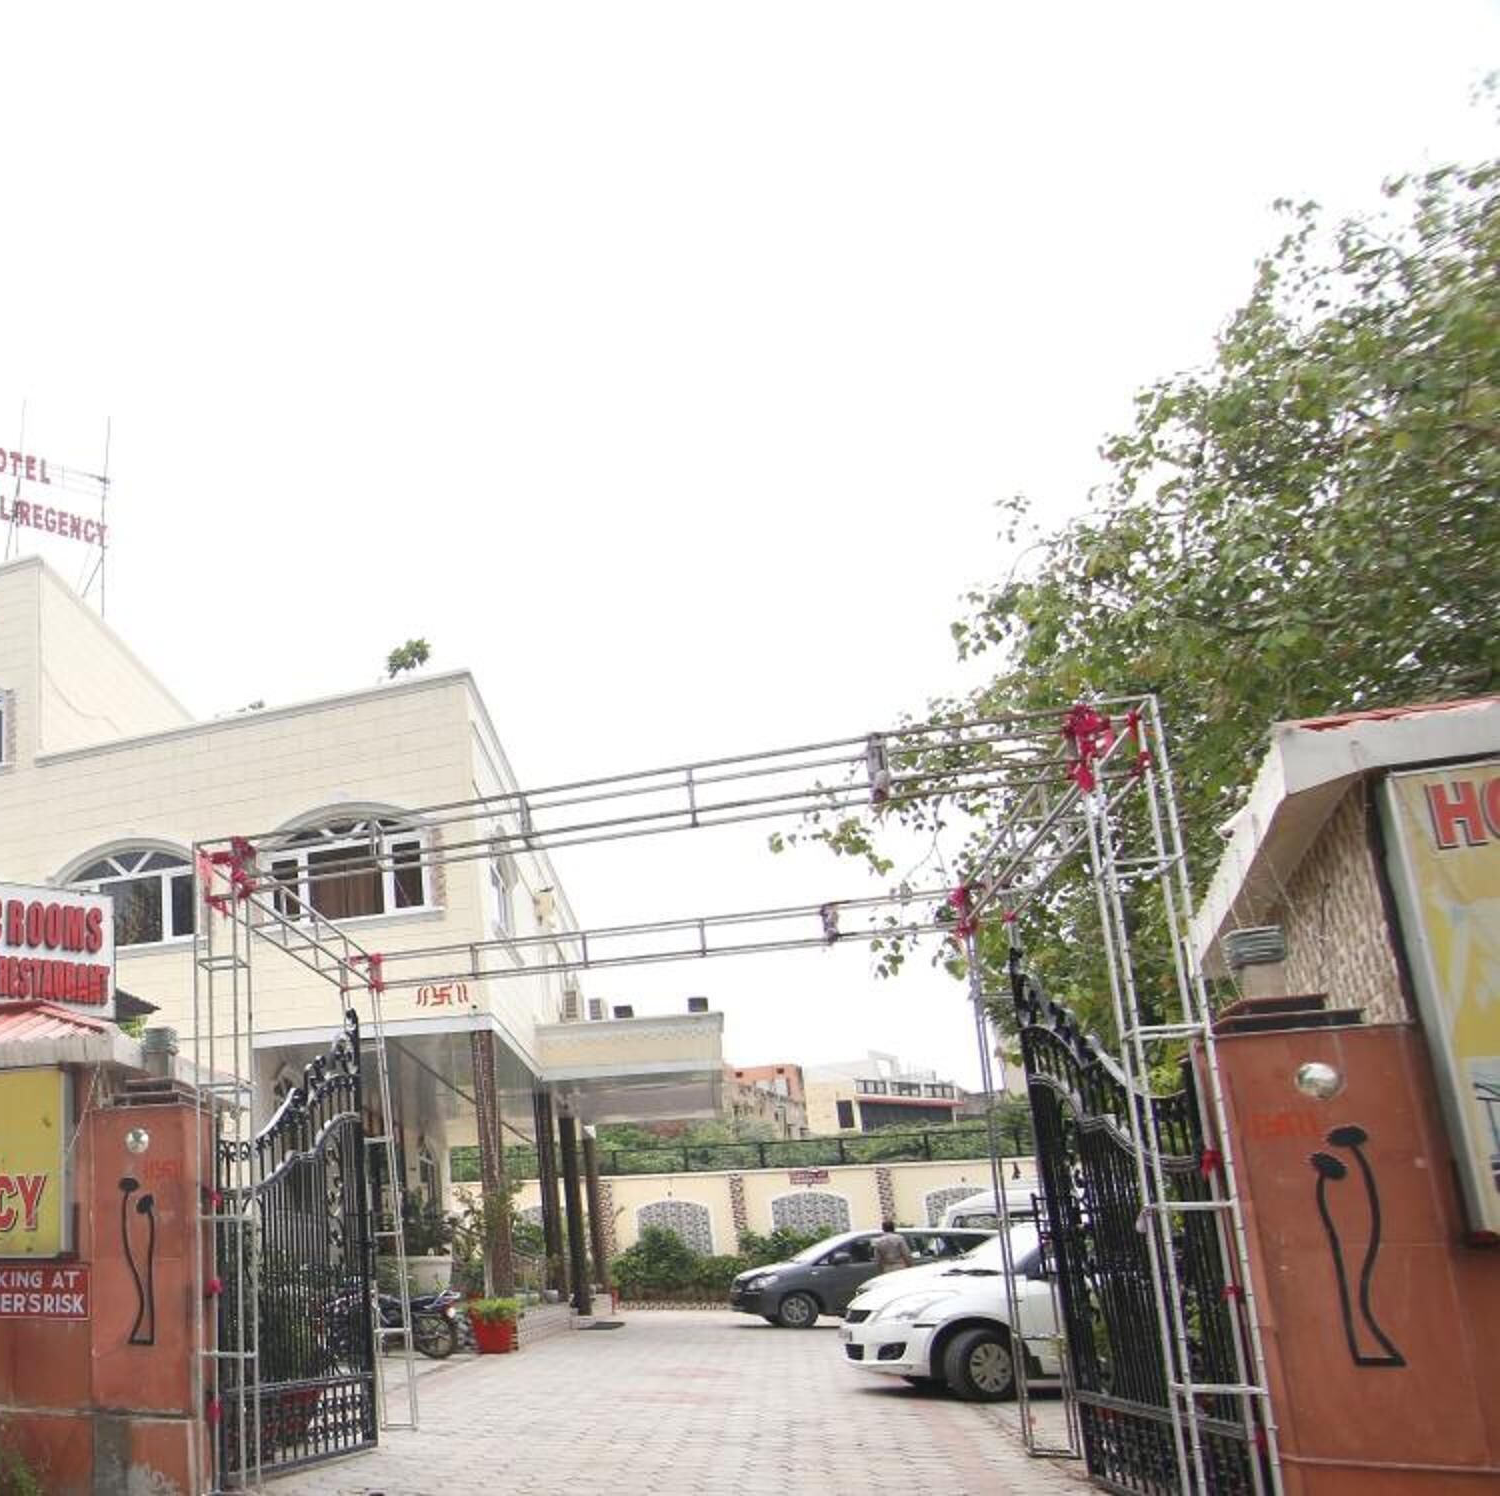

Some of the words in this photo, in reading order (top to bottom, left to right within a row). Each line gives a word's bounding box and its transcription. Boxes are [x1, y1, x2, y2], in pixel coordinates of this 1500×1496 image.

[19, 501, 107, 545] REGENCY
[7, 899, 102, 953] ROOMS
[52, 1271, 79, 1288] AT
[43, 1294, 85, 1313] RISK
